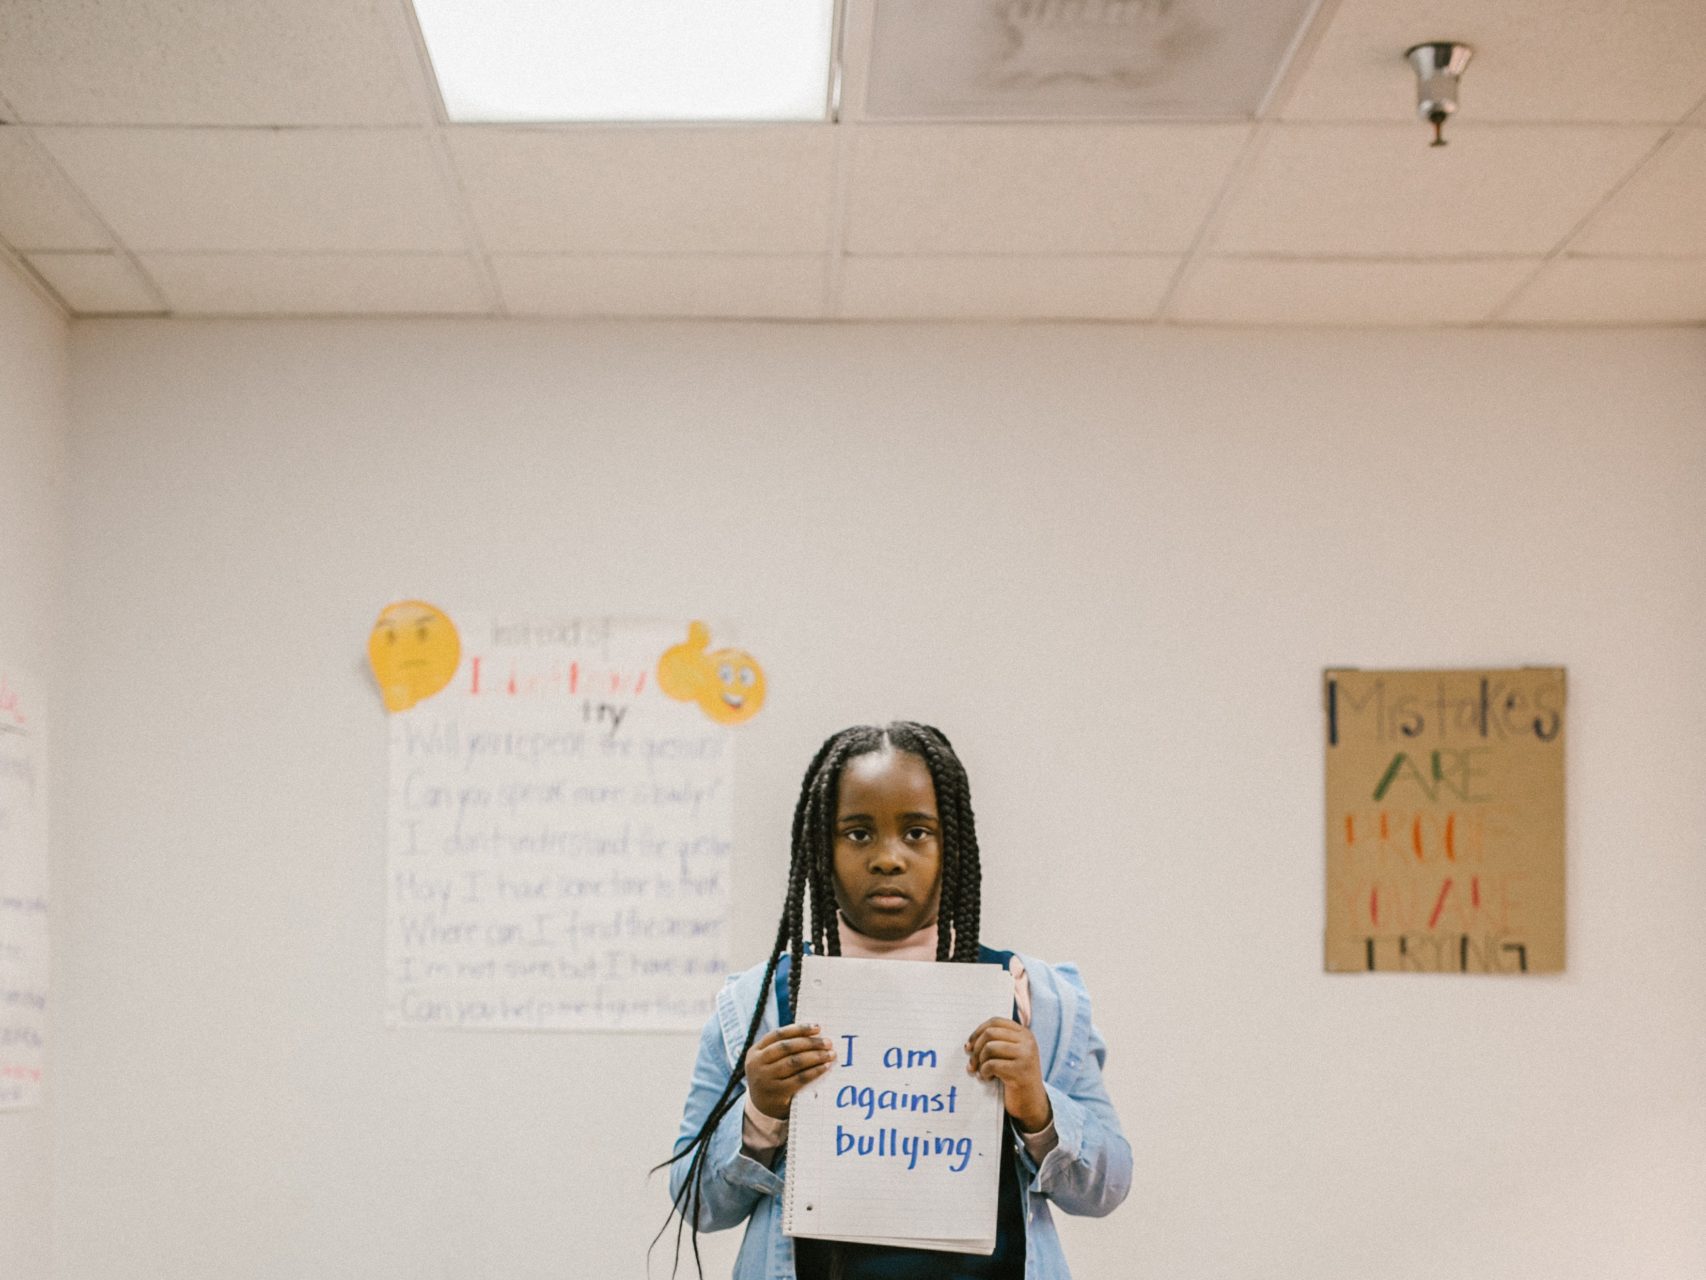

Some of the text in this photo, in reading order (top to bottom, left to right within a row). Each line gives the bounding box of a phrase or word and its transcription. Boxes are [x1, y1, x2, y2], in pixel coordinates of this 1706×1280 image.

[1326, 676, 1562, 748] Mistakes
[1372, 747, 1494, 803] ARE
[1353, 932, 1530, 972] TRYING
[841, 1035, 937, 1069] I am
[836, 1083, 957, 1120] against
[836, 1125, 984, 1172] bullying.
